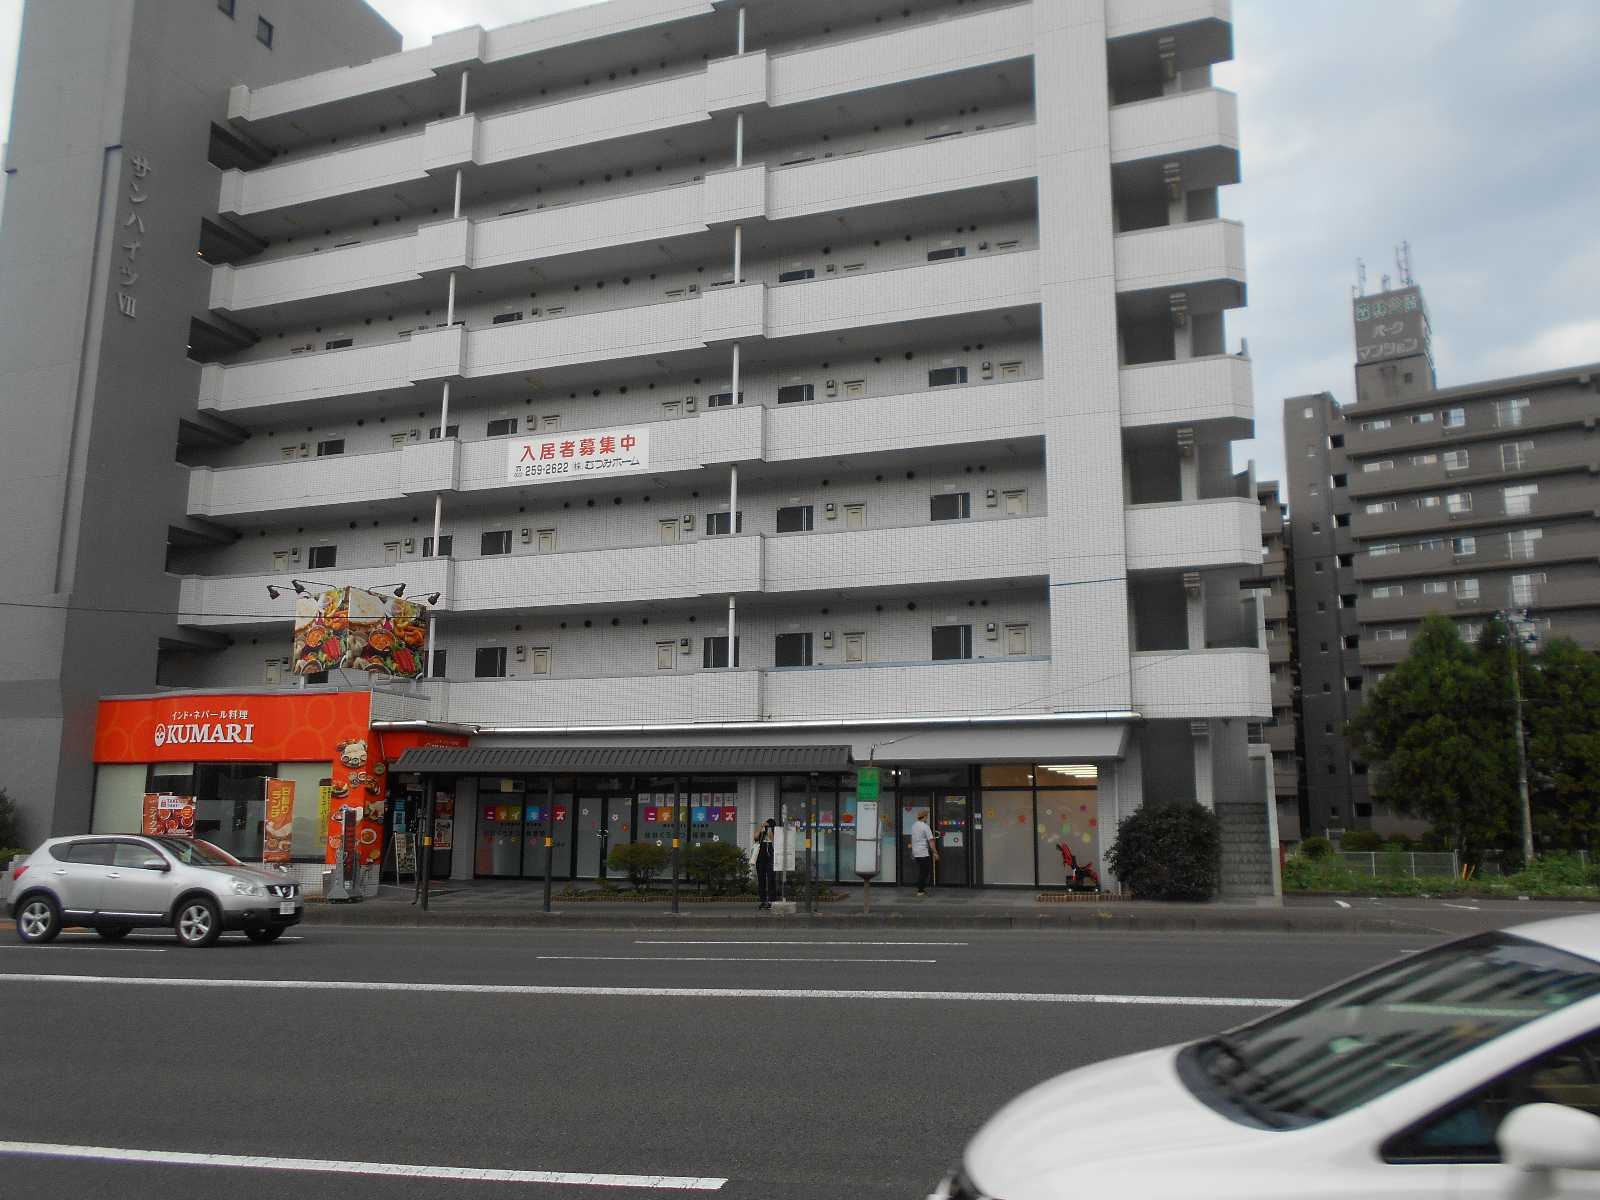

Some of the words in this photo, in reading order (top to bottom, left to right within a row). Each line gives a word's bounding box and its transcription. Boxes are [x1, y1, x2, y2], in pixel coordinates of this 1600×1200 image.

[520, 435, 636, 462] 入居者募集中
[171, 709, 249, 720] インド・ネパール料理
[166, 723, 254, 744] KUMARI
[271, 790, 281, 818] ランチ
